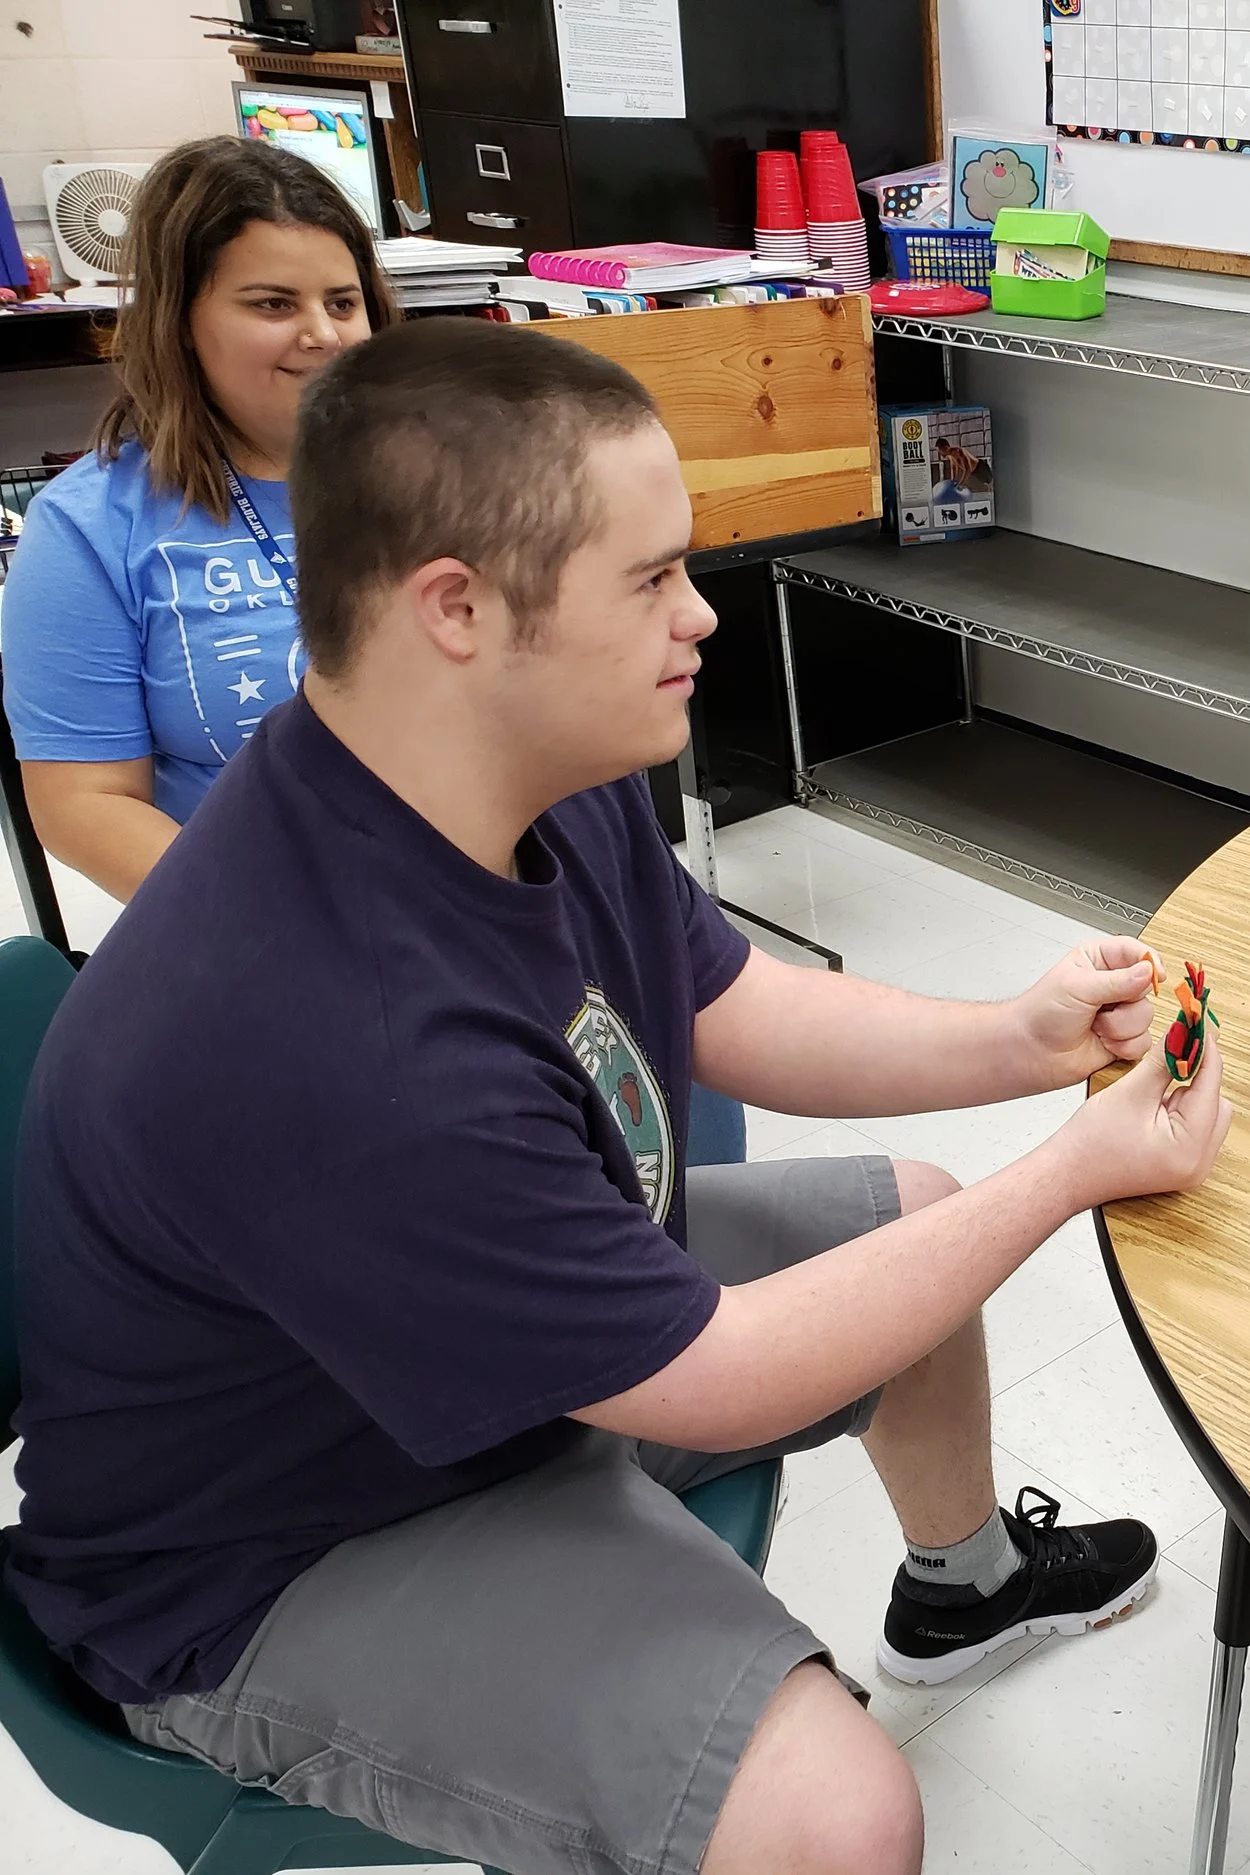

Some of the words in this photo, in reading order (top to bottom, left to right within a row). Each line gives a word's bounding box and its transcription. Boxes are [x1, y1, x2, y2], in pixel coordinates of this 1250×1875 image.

[902, 441, 923, 452] BODY
[903, 449, 924, 460] BALL
[236, 497, 269, 541] BLUEJAYS
[204, 555, 297, 596] GU
[927, 1630, 967, 1641] Reebok
